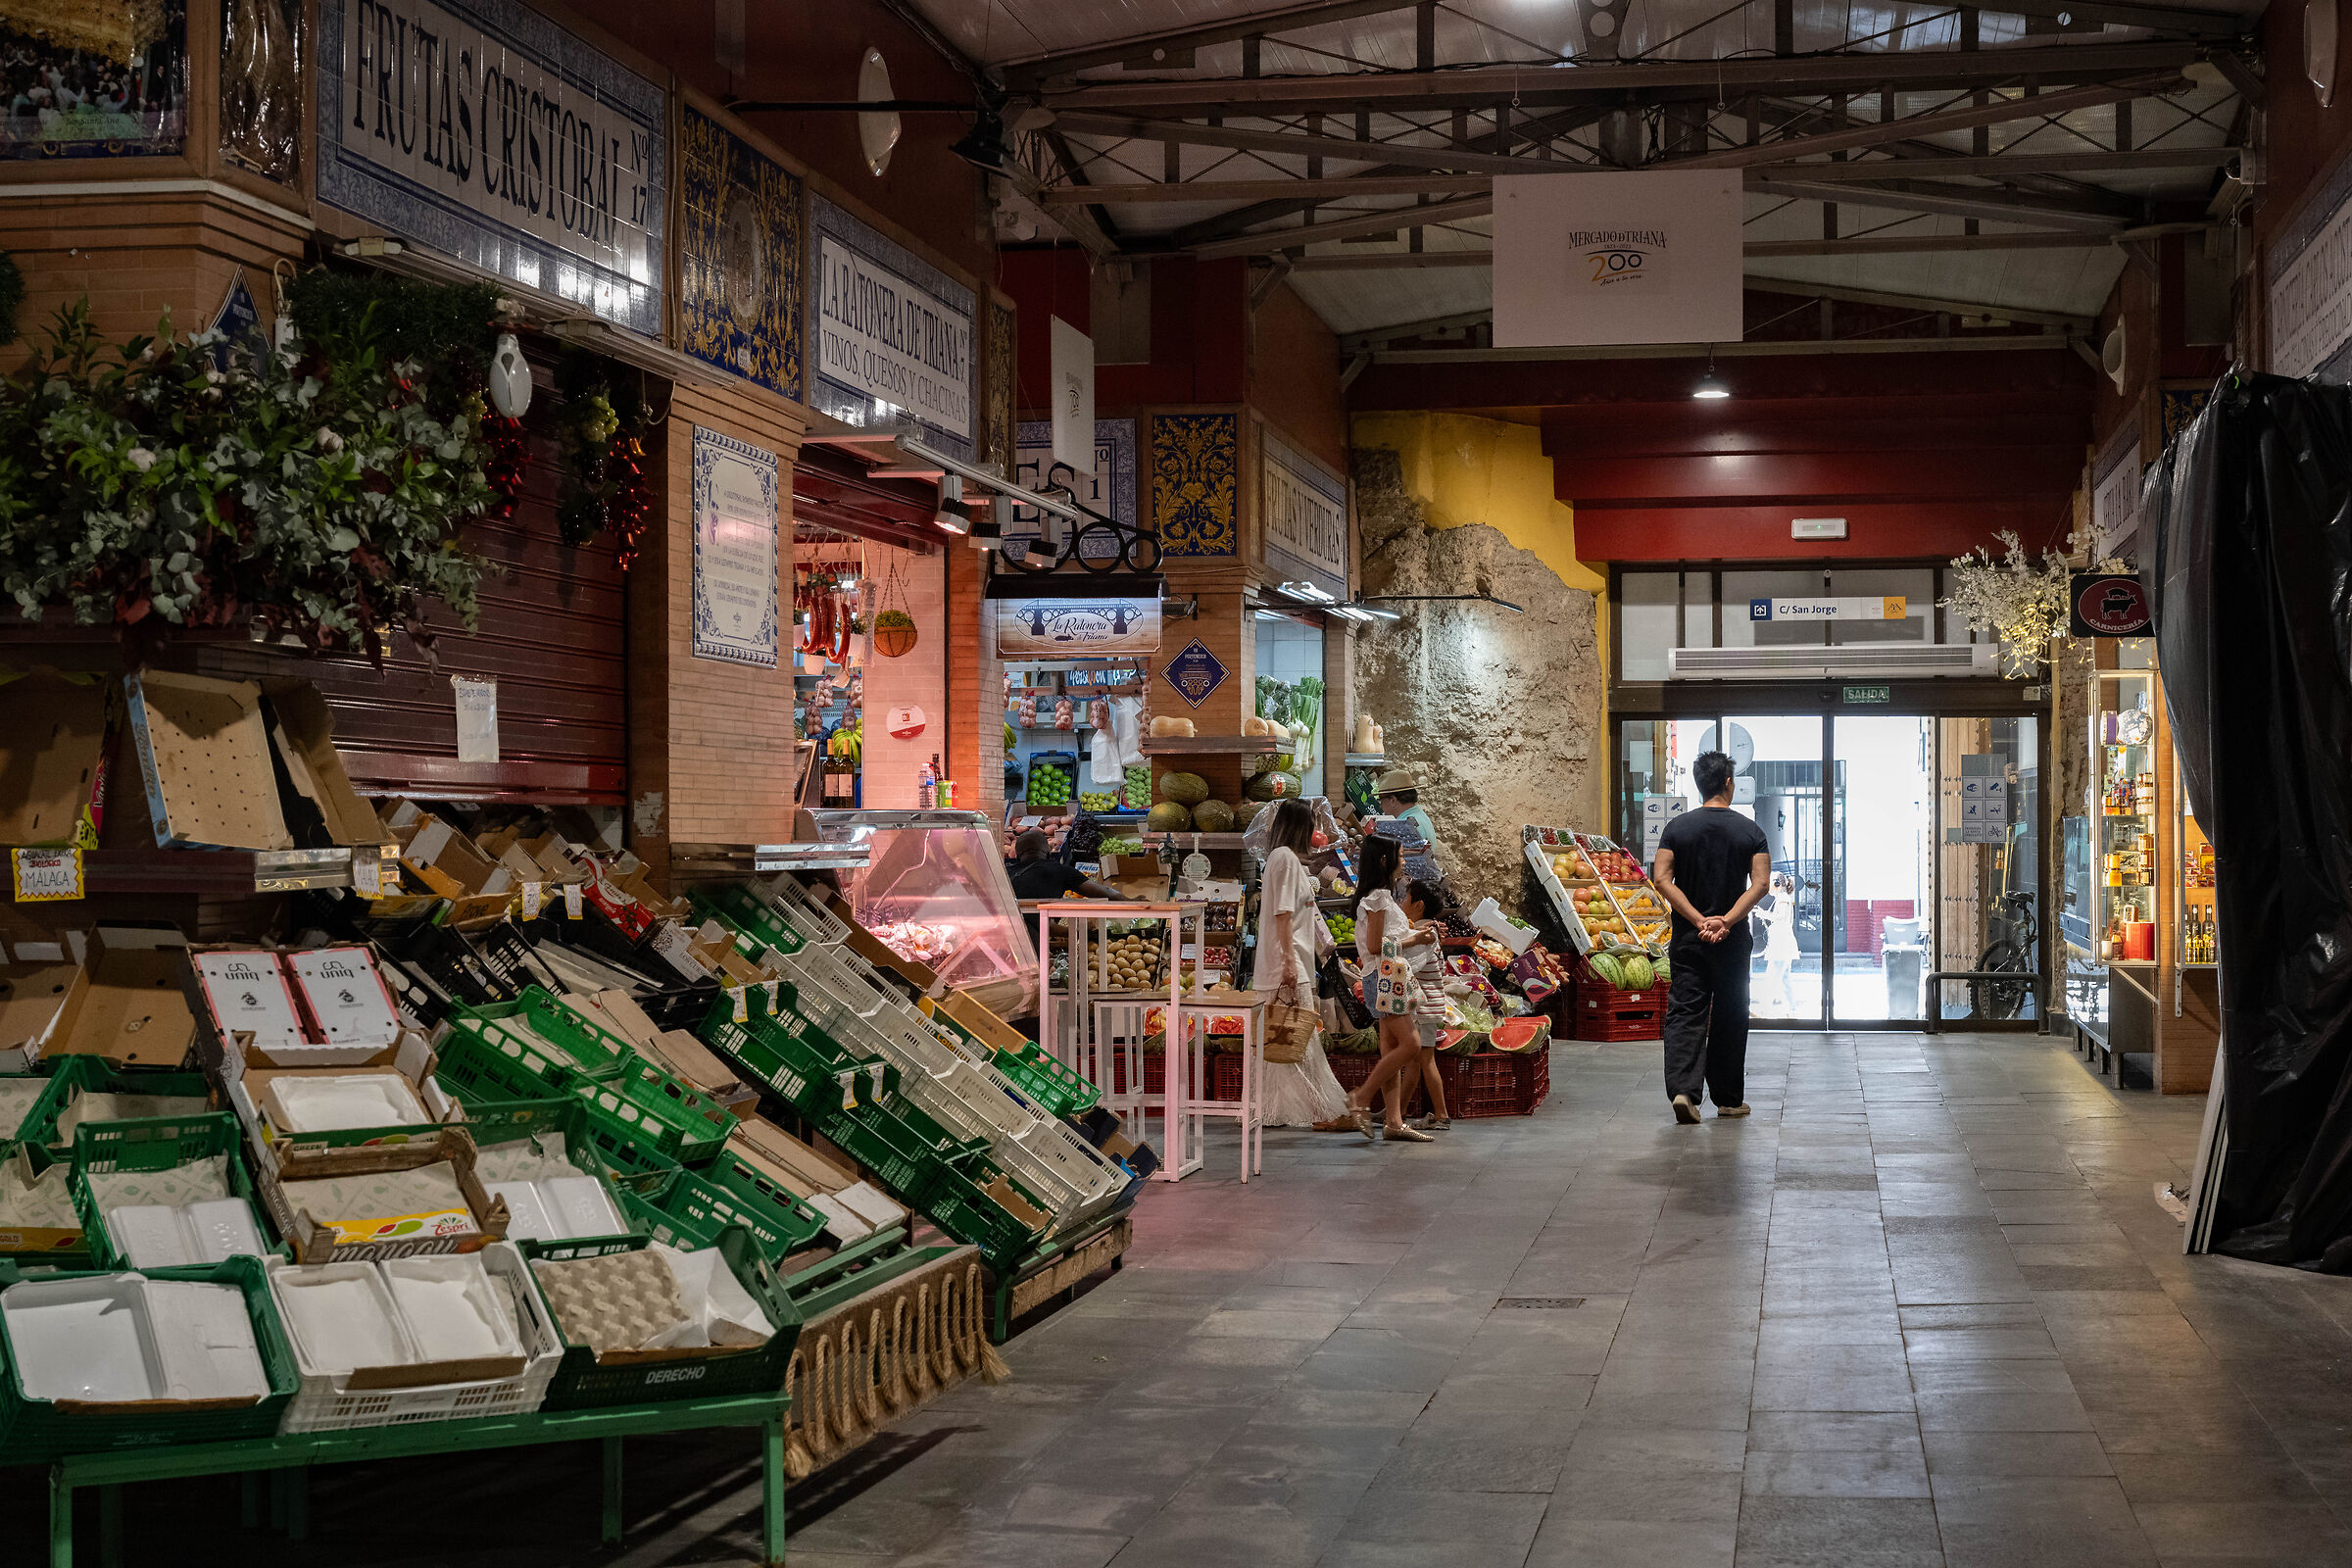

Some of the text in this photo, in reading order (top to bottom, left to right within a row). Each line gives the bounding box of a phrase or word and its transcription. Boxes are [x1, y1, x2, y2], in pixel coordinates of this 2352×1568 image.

[353, 0, 623, 255] FRUTAS CRISTOBAL
[631, 128, 648, 174] Nº
[631, 183, 648, 226] 17
[1568, 230, 1617, 250] MERCADO
[1626, 230, 1667, 249] TRIANA
[1588, 253, 1642, 282] 200
[822, 253, 959, 381] LA RATONERA DE TRIANA
[822, 329, 967, 425] VINOS, QUESOS Y CHACINAS
[1265, 469, 1296, 544] FRUTAS
[1301, 494, 1340, 565] VERDURAS
[1779, 605, 1838, 616] C/ San Jorge
[2089, 618, 2145, 632] CARNICERÍA
[1082, 630, 1108, 643] Triana
[1848, 689, 1886, 700] SALIDA
[24, 869, 71, 888] MÁLAGA
[431, 1221, 468, 1238] Zespri
[644, 1365, 706, 1386] DERECHO
